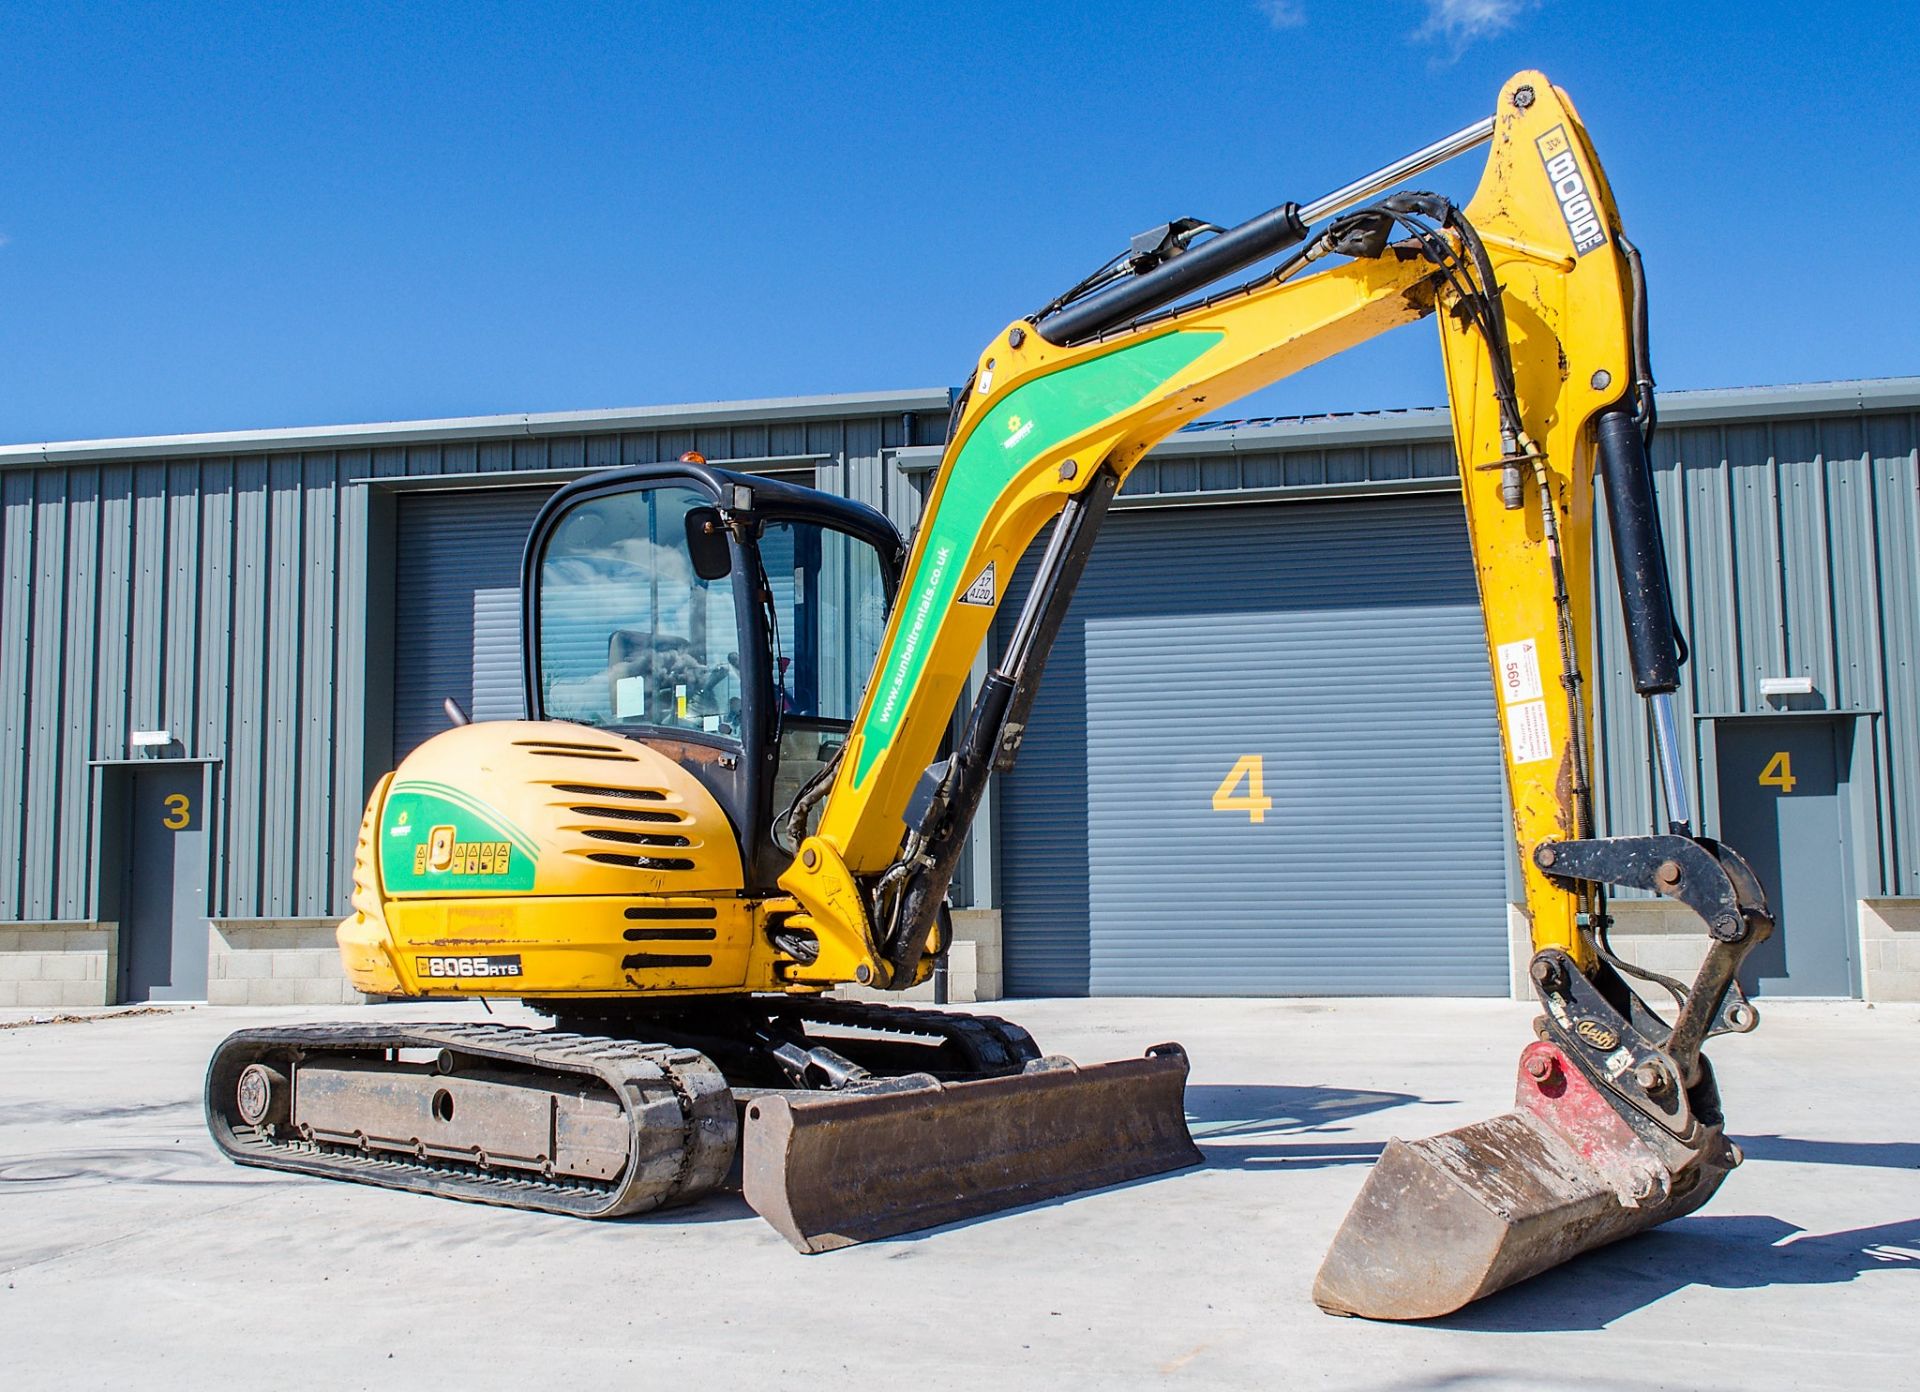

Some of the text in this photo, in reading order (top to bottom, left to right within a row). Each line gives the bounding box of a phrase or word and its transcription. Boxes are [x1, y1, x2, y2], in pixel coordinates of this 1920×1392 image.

[1546, 151, 1601, 243] 8065
[979, 576, 991, 587] 17
[879, 546, 951, 723] www.sunbeltrentals.co.uk
[1506, 662, 1521, 688] 560
[1212, 754, 1272, 823] 4
[1759, 751, 1797, 793] 4
[163, 793, 190, 830] 3
[429, 957, 488, 977] 8065
[489, 965, 519, 976] RTS
